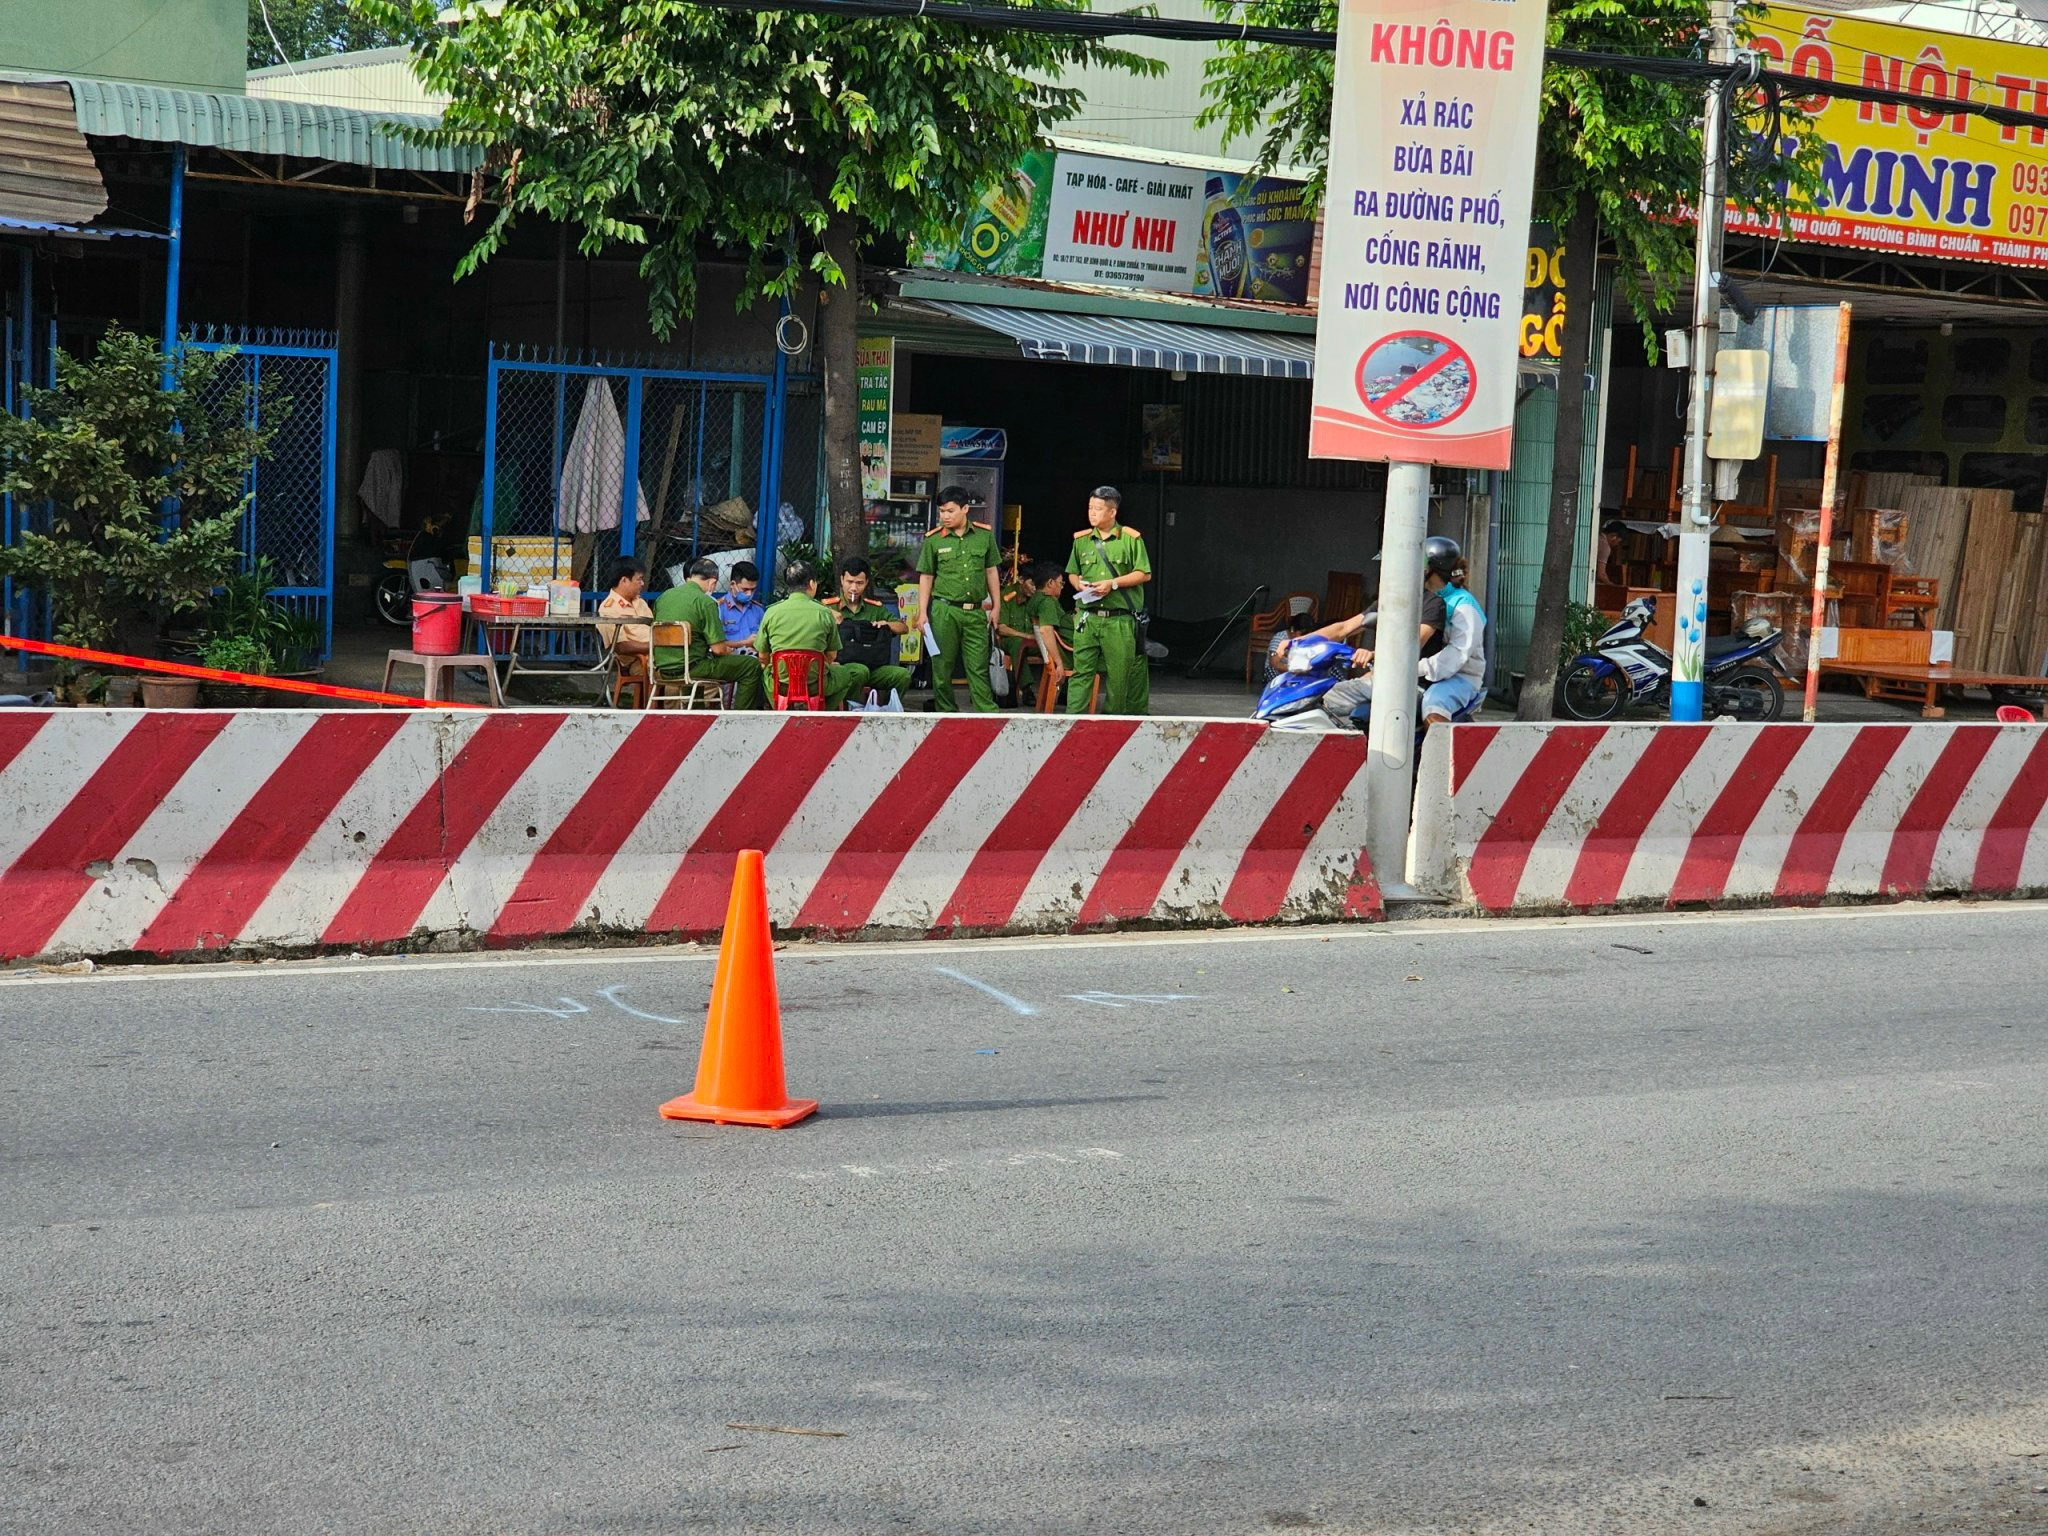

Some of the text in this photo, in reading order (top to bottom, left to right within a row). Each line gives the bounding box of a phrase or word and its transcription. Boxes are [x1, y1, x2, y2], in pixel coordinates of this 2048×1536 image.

[1370, 18, 1515, 71] KHÔNG
[1400, 91, 1474, 130] XẢ RÁC
[1858, 46, 1972, 146] NỘI
[1393, 141, 1474, 176] BỪA BÃI
[1066, 172, 1085, 189] TẠP
[1086, 173, 1107, 190] HÓA
[1115, 177, 1139, 194] CAFÉ
[1146, 179, 1166, 197] GIẢI
[1168, 182, 1194, 200] KHÁT
[1817, 143, 1997, 228] MINH
[1353, 187, 1505, 229] RA ĐƯỜNG PHỐ,
[2008, 203, 2048, 236] 097
[1072, 209, 1130, 248] NHƯ
[1131, 216, 1177, 253] NHI
[1365, 229, 1486, 275] CỐNG RÃNH,
[1810, 220, 1841, 237] QUỚI
[1853, 223, 1904, 245] PHƯỜNG
[1907, 229, 1937, 247] BÌNH
[1939, 234, 1981, 252] CHUẨN
[1992, 240, 2031, 258] THÀNH
[1344, 280, 1501, 323] NƠI CÔNG CỘNG
[861, 417, 887, 434] CAM ÉP
